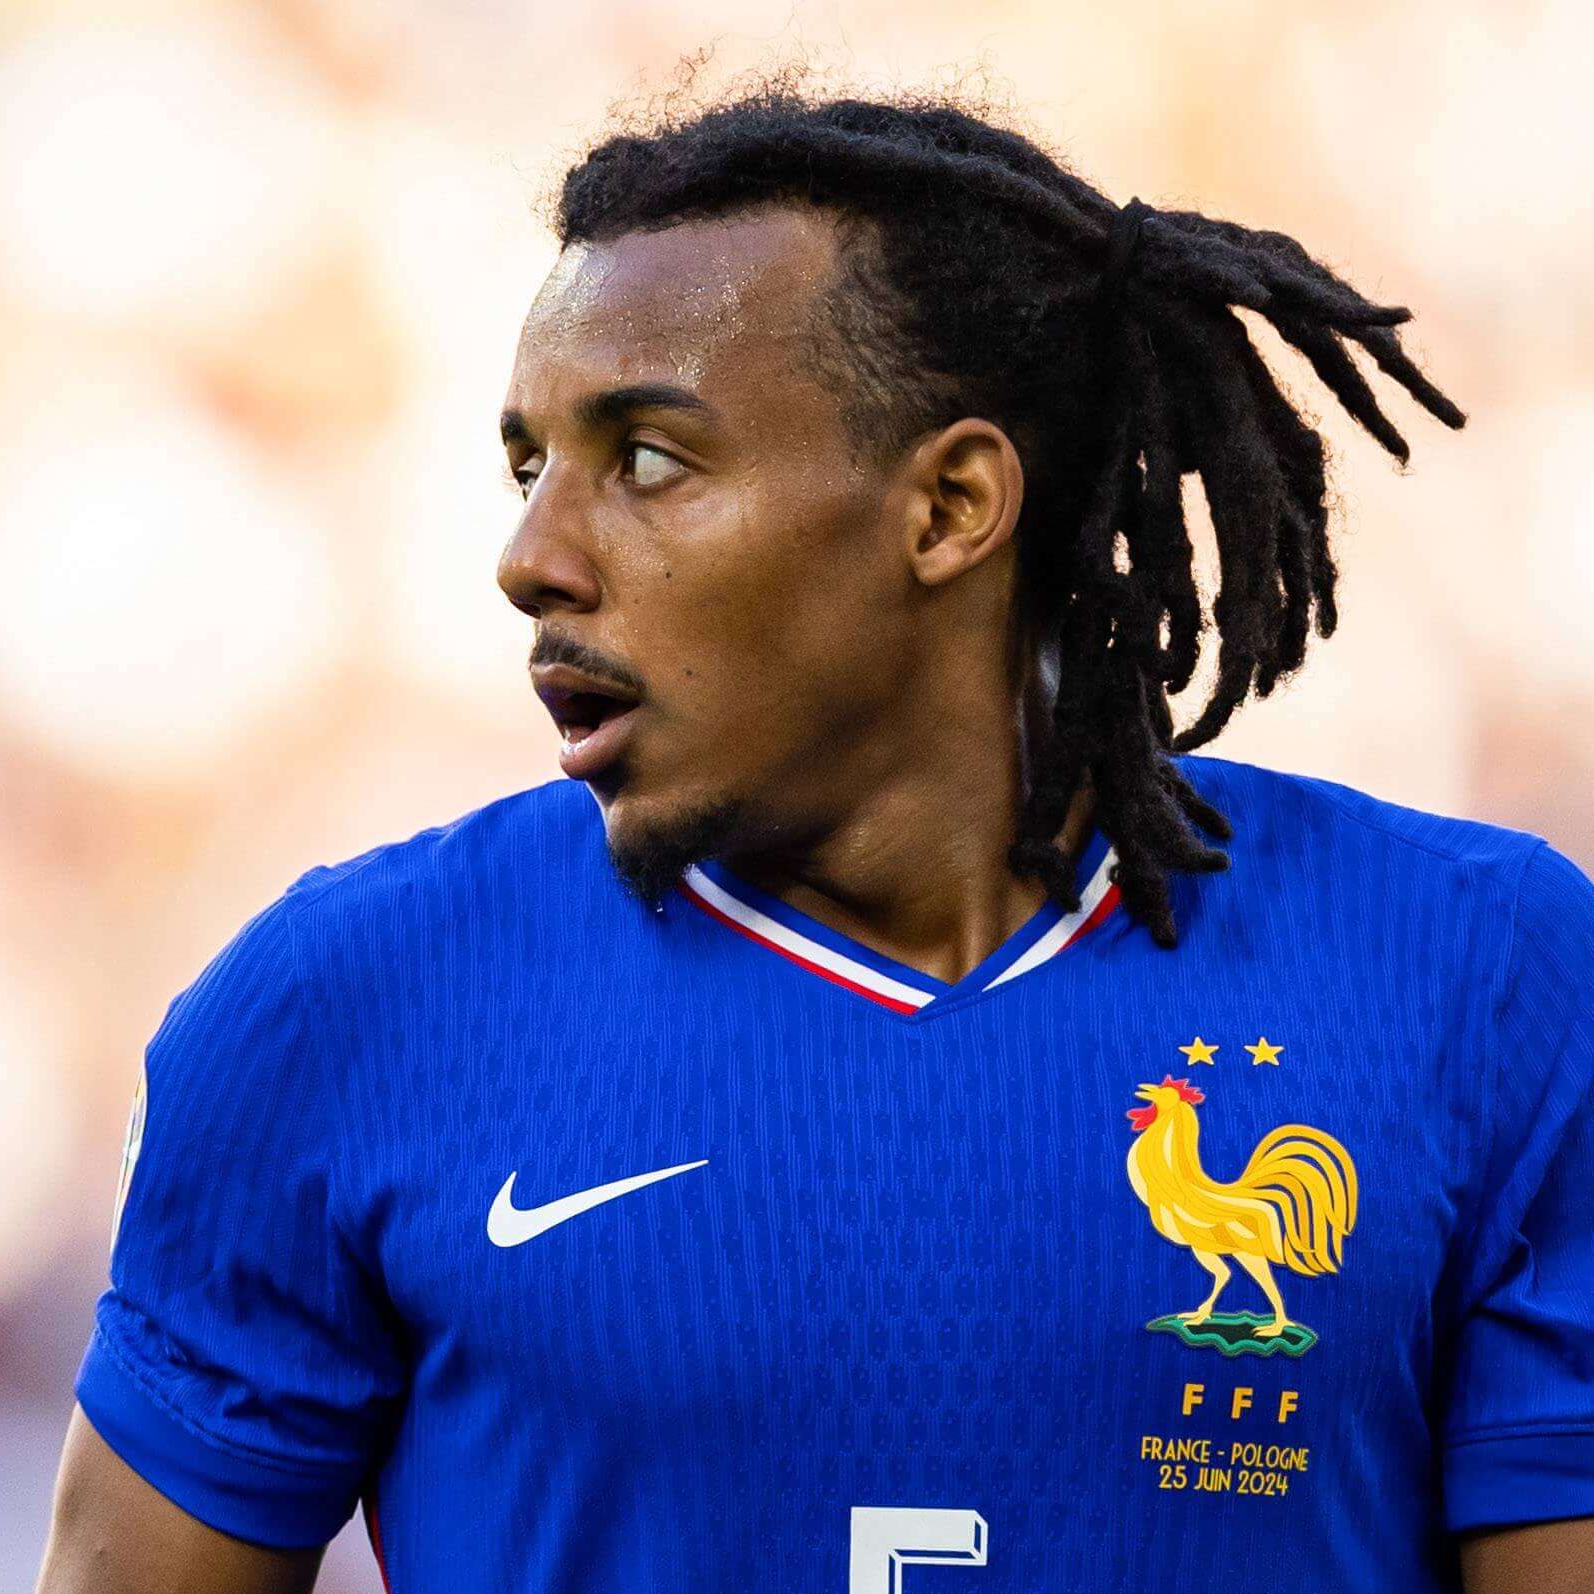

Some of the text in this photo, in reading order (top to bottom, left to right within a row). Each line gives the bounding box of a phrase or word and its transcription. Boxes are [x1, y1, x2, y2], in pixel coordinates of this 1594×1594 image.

[1141, 1436, 1211, 1463] FRANCE
[1230, 1442, 1309, 1471] POLOGNE
[1159, 1464, 1288, 1496] 25 JUIN 2024
